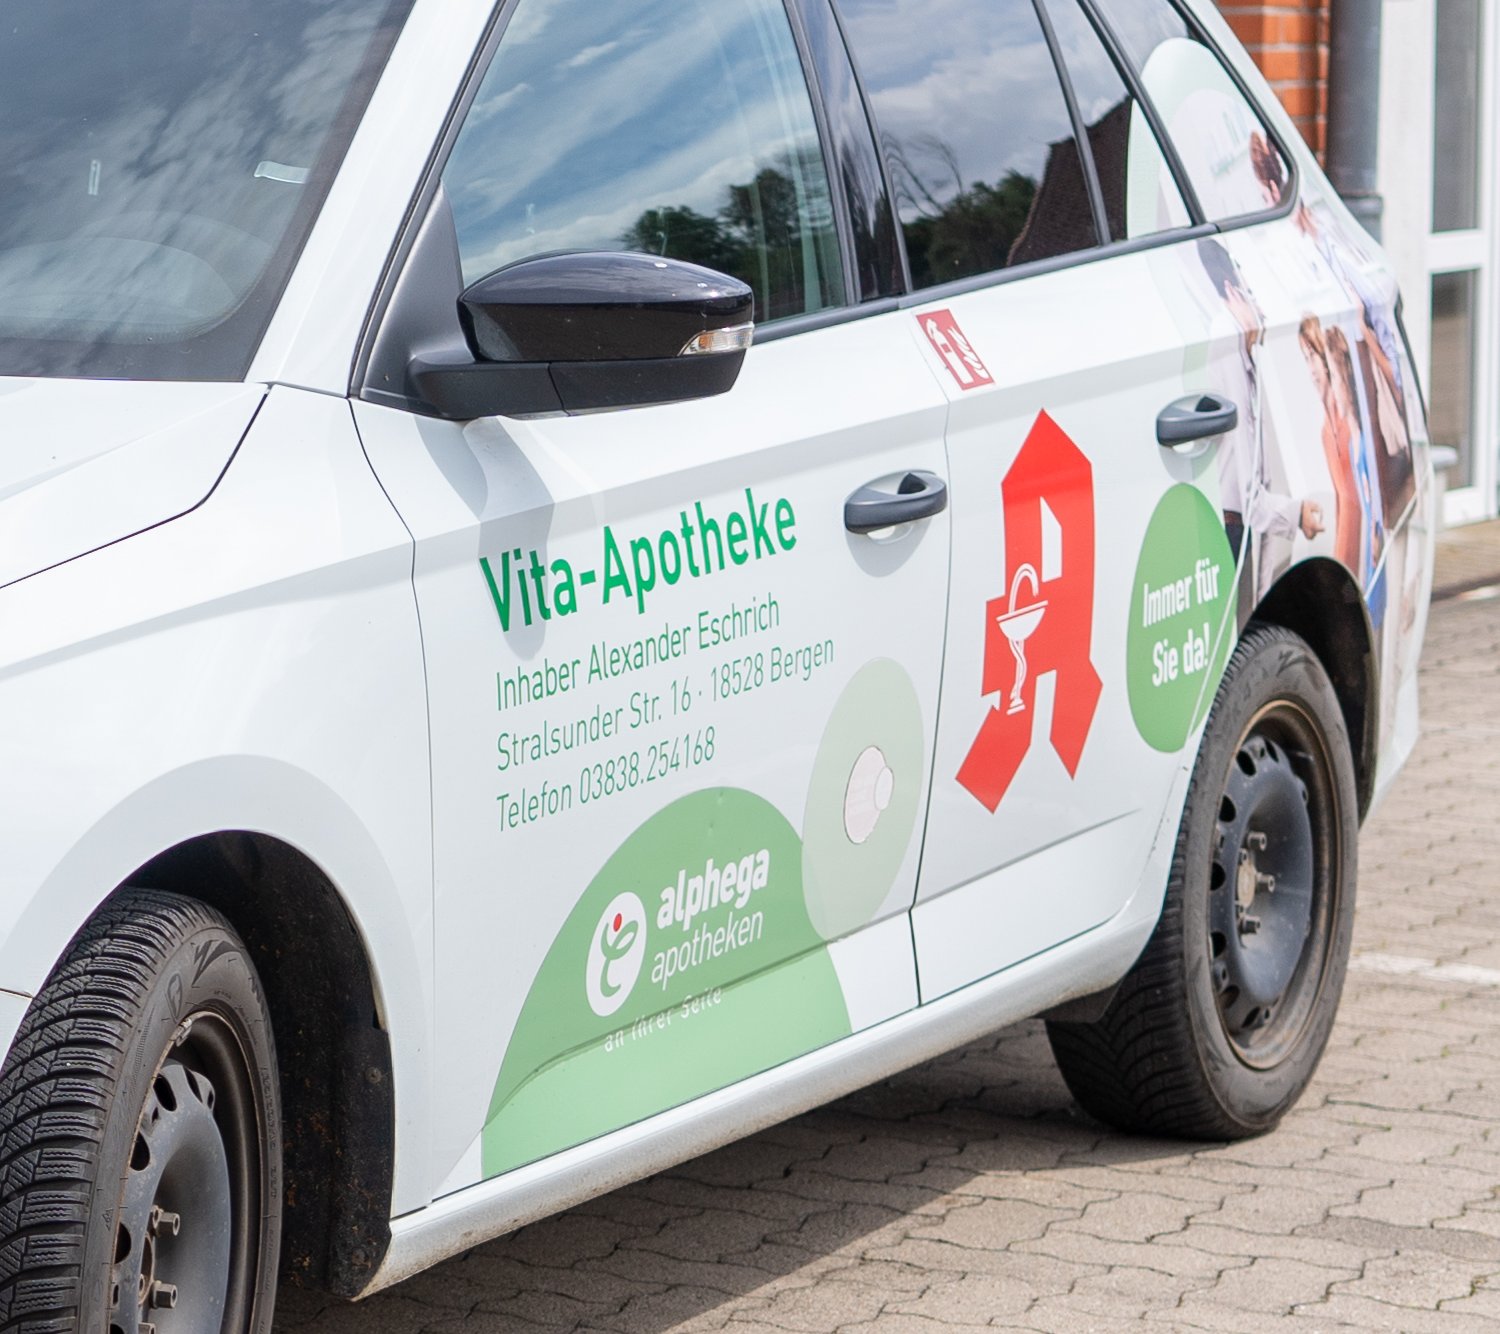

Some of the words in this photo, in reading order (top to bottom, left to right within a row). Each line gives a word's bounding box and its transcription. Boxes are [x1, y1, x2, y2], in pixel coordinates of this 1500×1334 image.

[479, 487, 797, 632] Vita-Apotheke
[1143, 574, 1192, 628] Immer
[1195, 557, 1220, 605] für
[496, 657, 581, 711] Inhaber
[587, 622, 692, 684] Alexander
[699, 591, 780, 650] Eschrich
[1152, 638, 1179, 687] Sie
[1183, 621, 1210, 673] da!
[497, 704, 623, 771] Stralsunder
[629, 690, 662, 729] Str.
[670, 675, 692, 716] 16
[711, 651, 764, 702] 18528
[771, 638, 834, 682] Bergen
[497, 780, 572, 832] Telefon
[580, 725, 716, 804] 03838.254168
[656, 848, 770, 932] alphega
[651, 911, 764, 991] apotheken
[604, 1030, 625, 1053] an
[631, 1007, 674, 1041] Ihrer
[681, 986, 722, 1019] Seite
